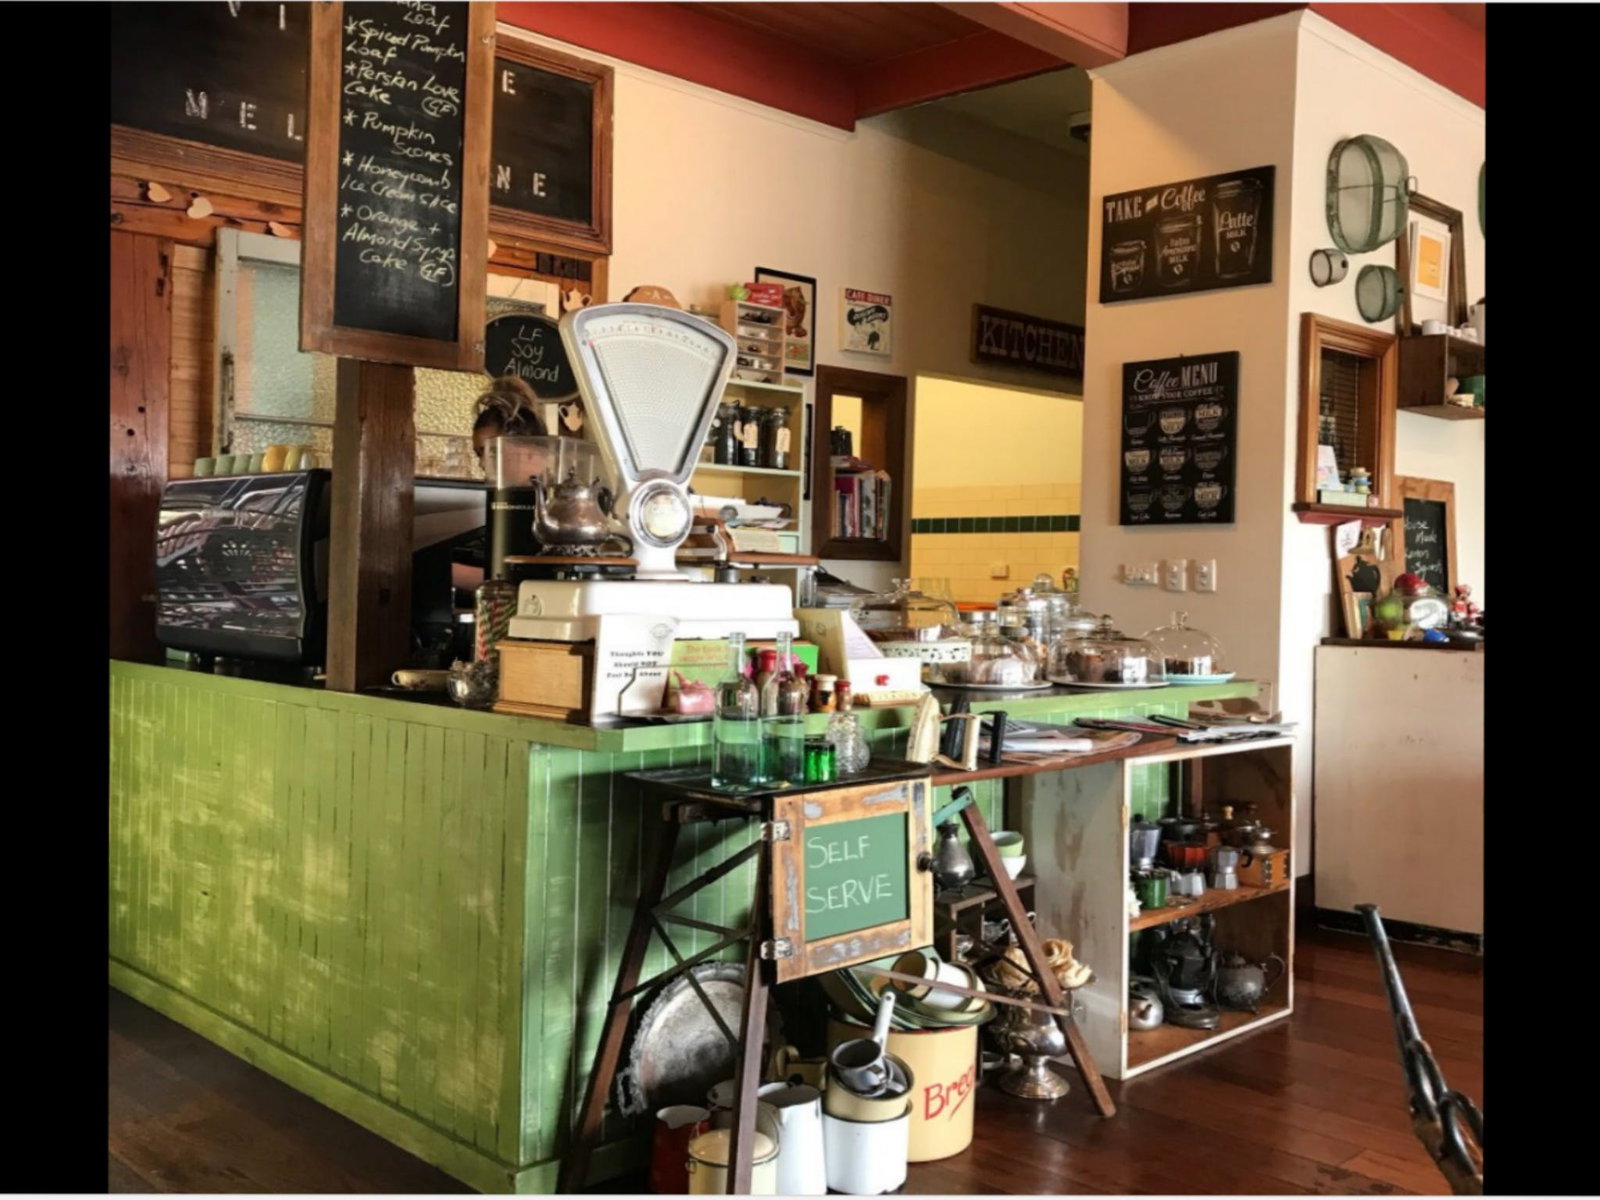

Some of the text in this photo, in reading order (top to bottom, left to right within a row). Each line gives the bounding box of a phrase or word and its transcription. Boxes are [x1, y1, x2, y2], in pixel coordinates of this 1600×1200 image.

[358, 19, 411, 45] Spiced
[403, 11, 450, 35] Loaf
[346, 40, 397, 65] Loaf
[344, 81, 392, 105] Cake
[357, 60, 460, 103] Persian Love
[362, 112, 435, 144] Pumpkin
[392, 142, 453, 166] Scones
[358, 155, 450, 189] Honeycomb
[341, 174, 367, 192] Ice
[370, 181, 416, 202] Cream
[1105, 196, 1142, 223] TAKE
[1160, 184, 1206, 212] Coffee
[357, 205, 418, 235] Orange
[342, 222, 412, 250] Almond
[360, 249, 408, 270] Cake
[518, 325, 543, 341] LF
[980, 314, 1085, 370] KITCHEN
[511, 338, 544, 364] Soy
[504, 357, 559, 382] Almond
[1133, 362, 1218, 399] Coffee MENU
[1183, 386, 1213, 398] COFFEE
[610, 650, 644, 658] Thoughts
[806, 835, 872, 870] SELF
[805, 873, 894, 914] SERVE
